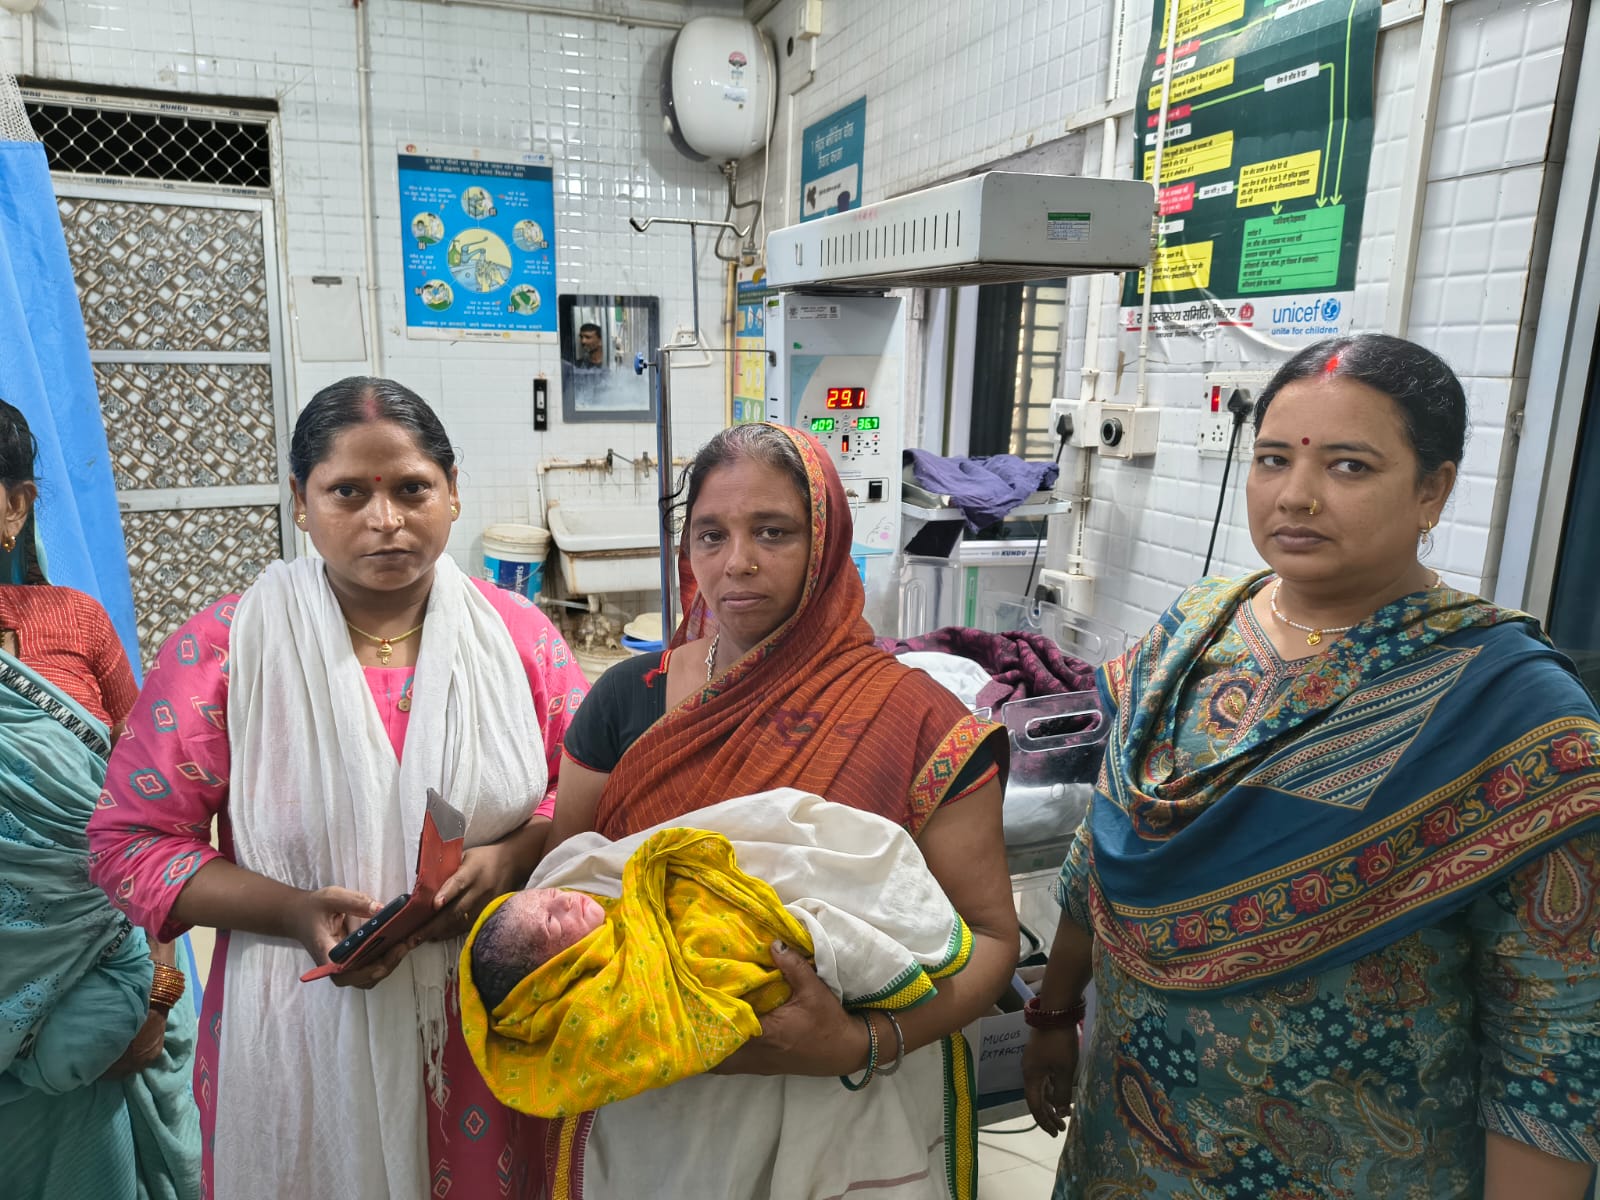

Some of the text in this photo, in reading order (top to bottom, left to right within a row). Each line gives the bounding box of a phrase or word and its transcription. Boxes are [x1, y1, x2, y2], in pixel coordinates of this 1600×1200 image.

[160, 103, 188, 112] KUNDU
[1272, 299, 1321, 323] unicef
[1271, 325, 1339, 335] unite for children
[827, 390, 865, 407] 29.1
[980, 1044, 1025, 1061] EXTRACT
